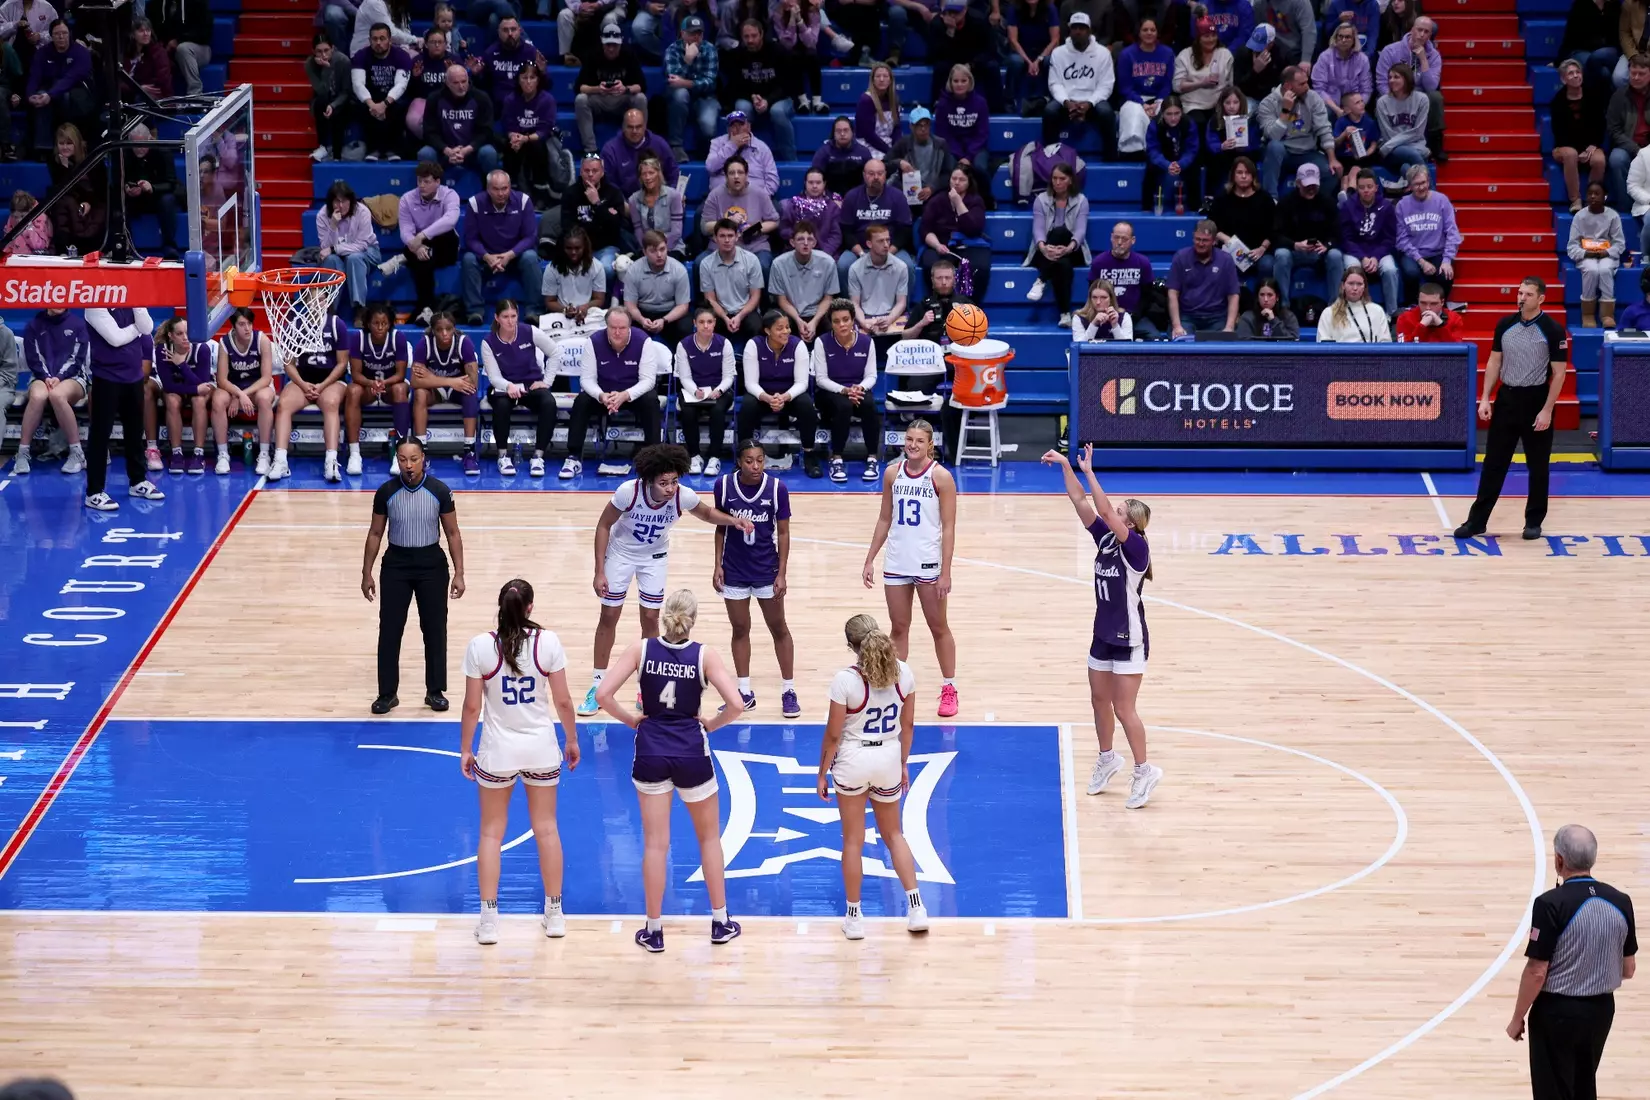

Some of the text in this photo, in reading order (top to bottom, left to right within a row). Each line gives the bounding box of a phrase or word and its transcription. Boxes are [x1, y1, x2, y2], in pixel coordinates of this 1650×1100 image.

[1063, 62, 1095, 80] Cats
[442, 109, 474, 120] K-STATE
[856, 209, 892, 217] K-STATE
[1100, 268, 1140, 280] K-STATE
[895, 345, 936, 355] Capitol
[231, 359, 260, 371] Wildcats
[895, 356, 936, 366] Federal
[983, 367, 998, 385] G
[1143, 380, 1295, 412] CHOICE
[1335, 393, 1434, 408] BOOK NOW
[893, 485, 933, 499] JAYHAWKS
[629, 511, 674, 524] JAYHAWKS
[730, 508, 769, 523] Wildcats
[897, 498, 921, 527] 13
[632, 522, 665, 545] 25
[1207, 532, 1503, 557] ALLEN
[22, 527, 184, 647] COURT
[1096, 578, 1111, 602] 11
[646, 660, 696, 680] CLAESSENS
[501, 675, 536, 706] 52
[658, 680, 677, 710] 4
[862, 702, 899, 734] 22
